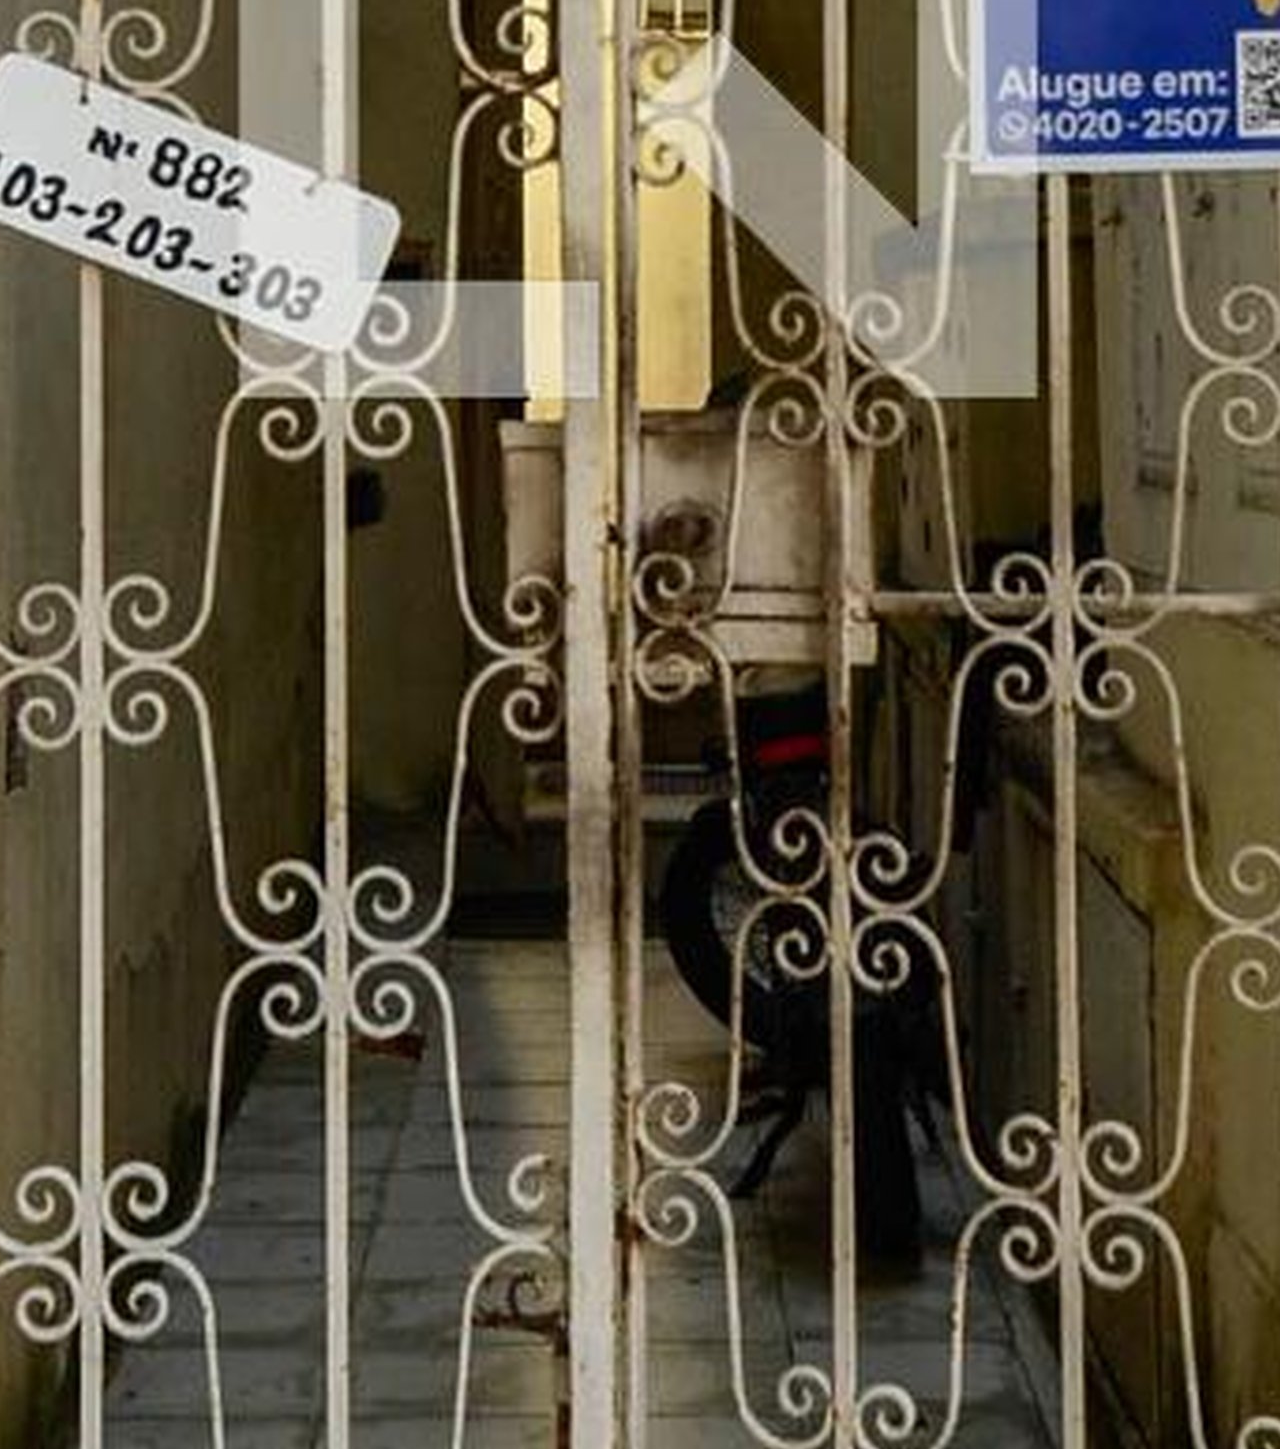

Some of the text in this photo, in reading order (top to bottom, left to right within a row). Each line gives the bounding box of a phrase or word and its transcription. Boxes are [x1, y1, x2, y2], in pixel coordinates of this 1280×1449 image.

[998, 66, 1229, 109] Alugue em:
[147, 136, 254, 215] 882
